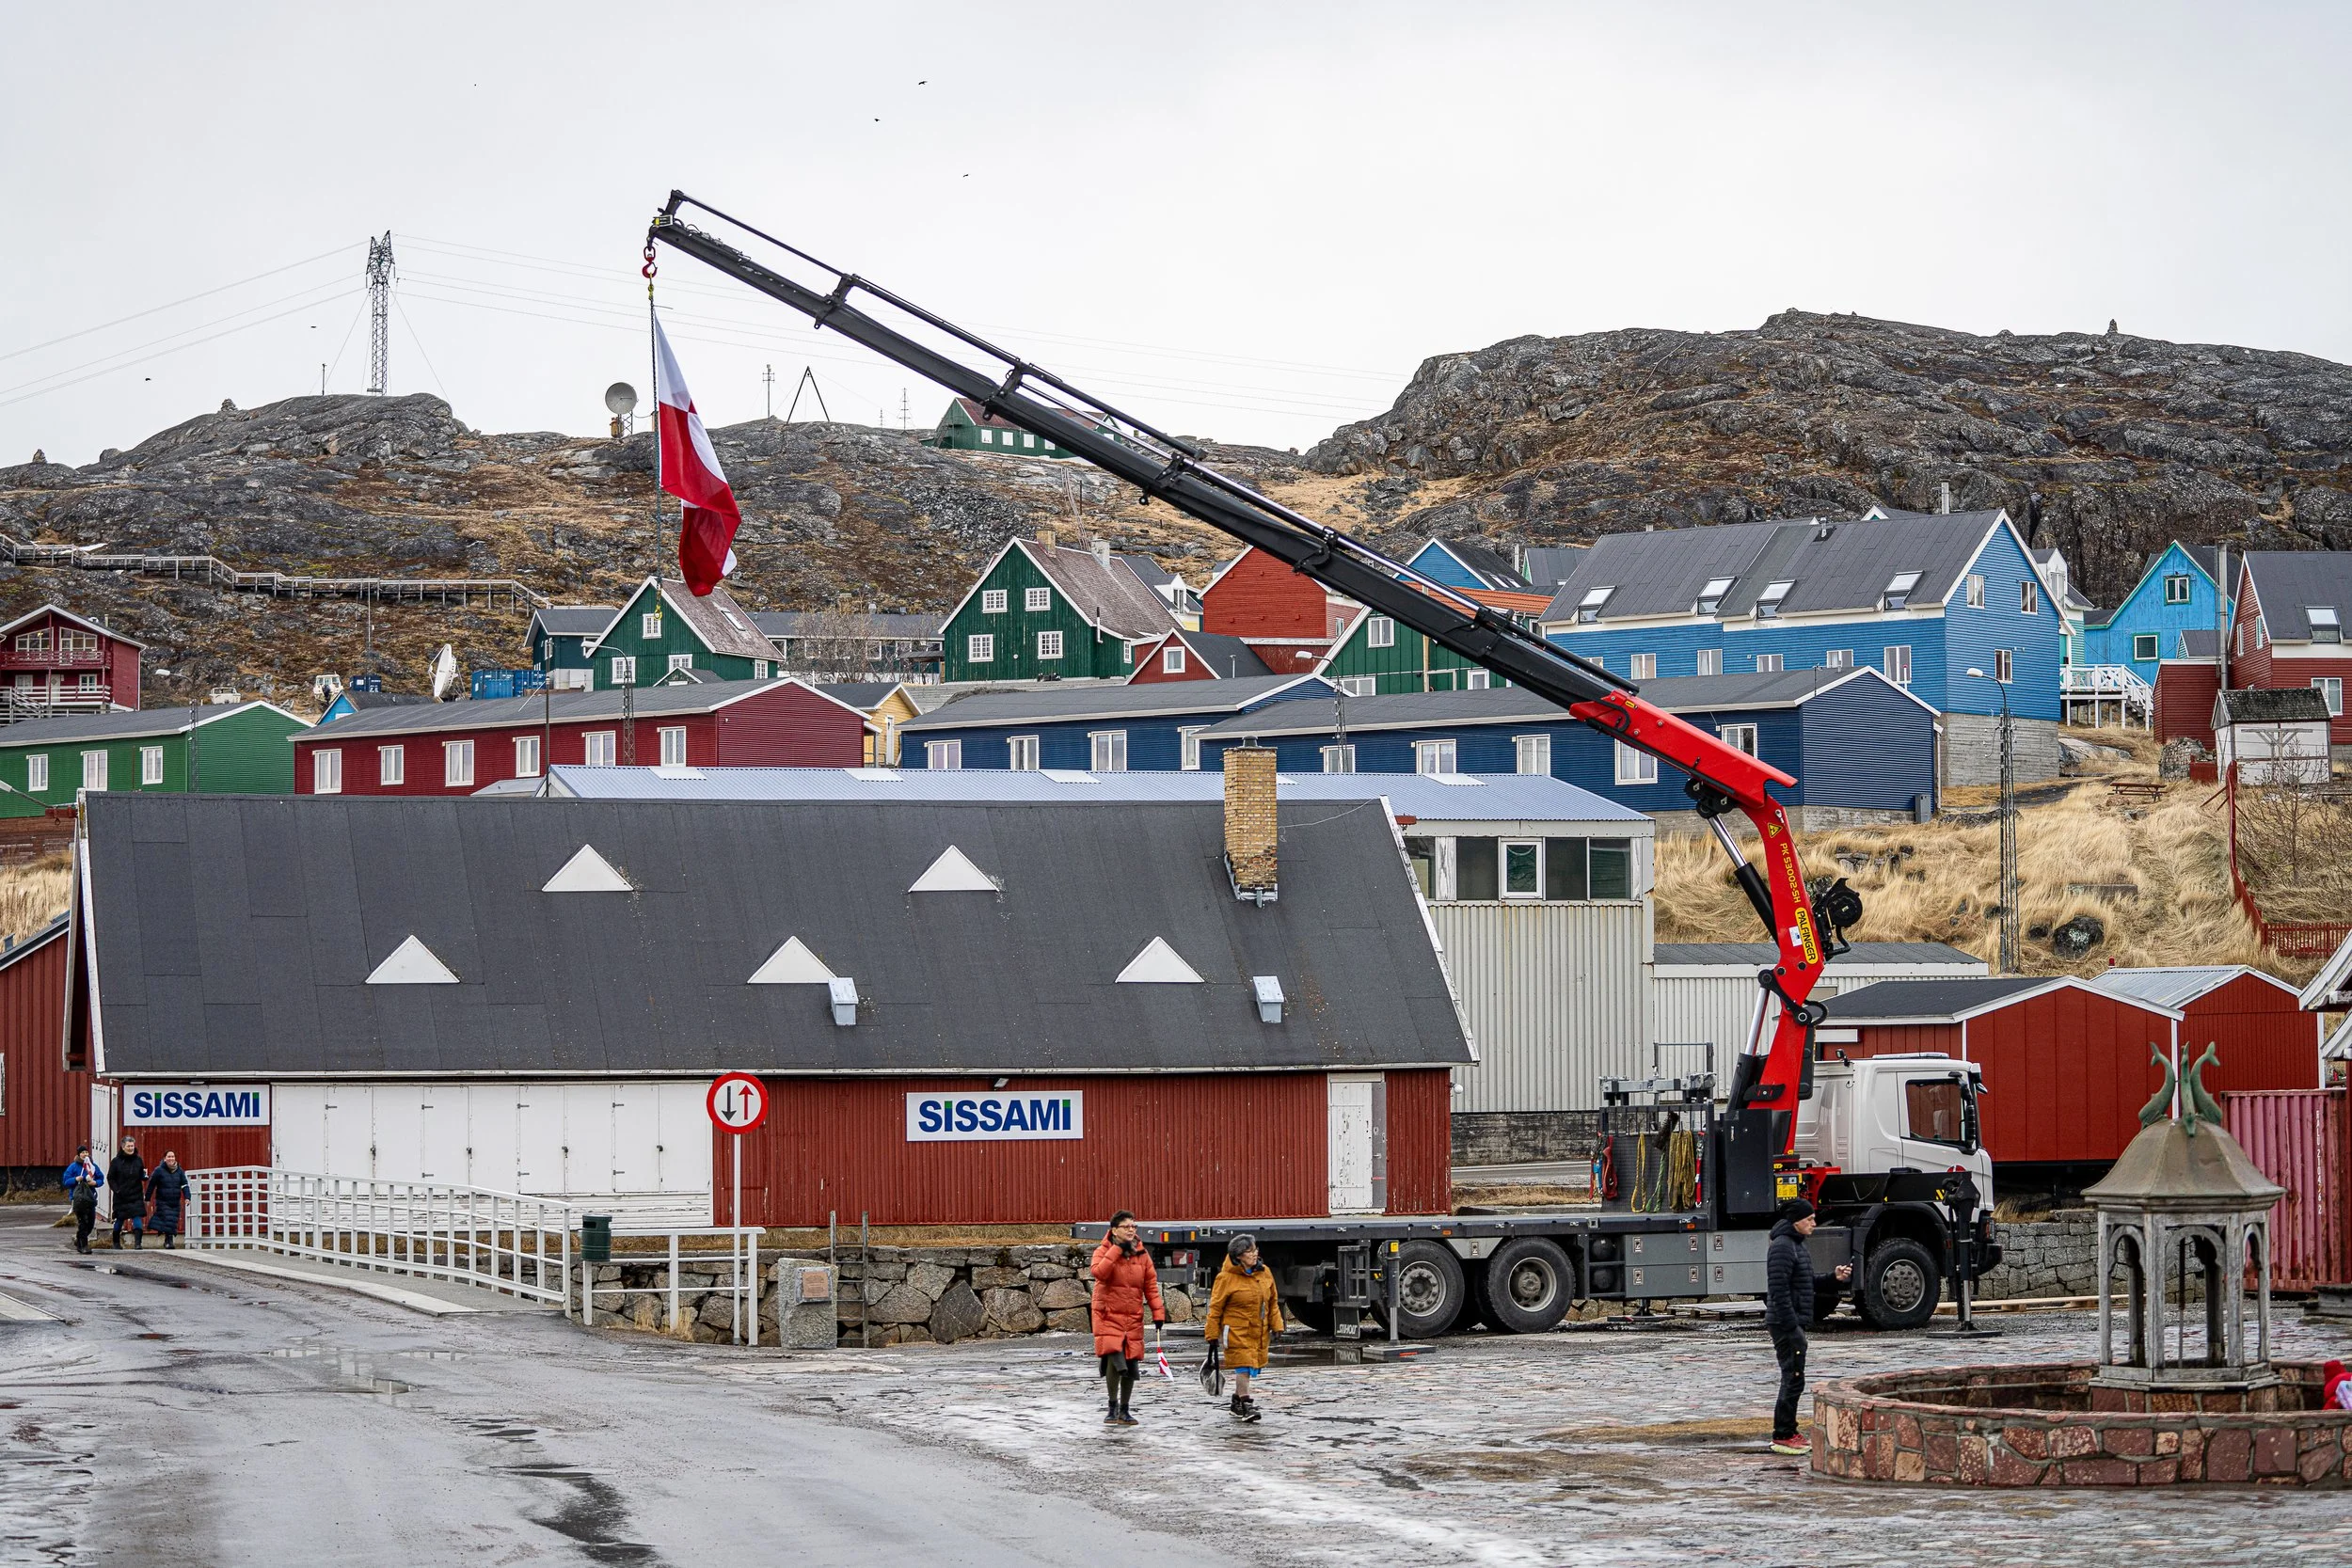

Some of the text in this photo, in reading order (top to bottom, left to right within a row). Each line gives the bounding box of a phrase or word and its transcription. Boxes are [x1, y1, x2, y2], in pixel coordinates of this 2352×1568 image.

[1780, 843, 1789, 856] PK
[1797, 911, 1817, 961] PALFINGER
[133, 1092, 260, 1118] SISSAMI
[918, 1099, 1072, 1132] SISSAMI
